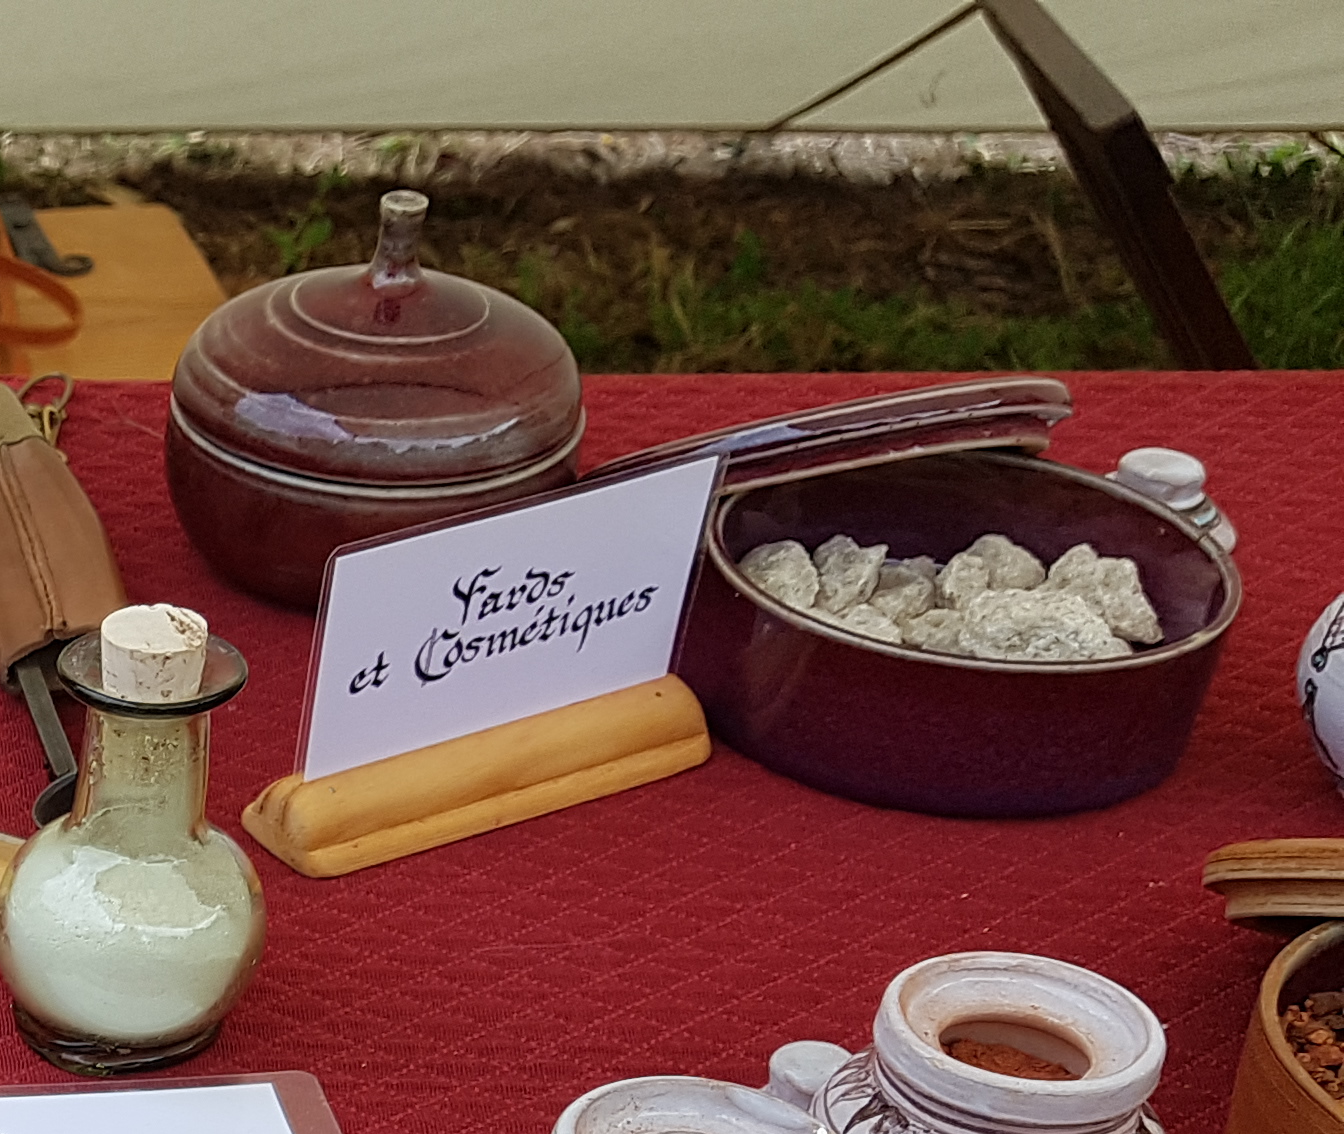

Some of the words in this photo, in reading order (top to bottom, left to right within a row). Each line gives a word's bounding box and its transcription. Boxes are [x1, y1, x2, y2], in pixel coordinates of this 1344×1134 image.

[452, 566, 576, 626] Fards
[348, 651, 391, 695] et
[414, 585, 659, 687] Cosmétiques
